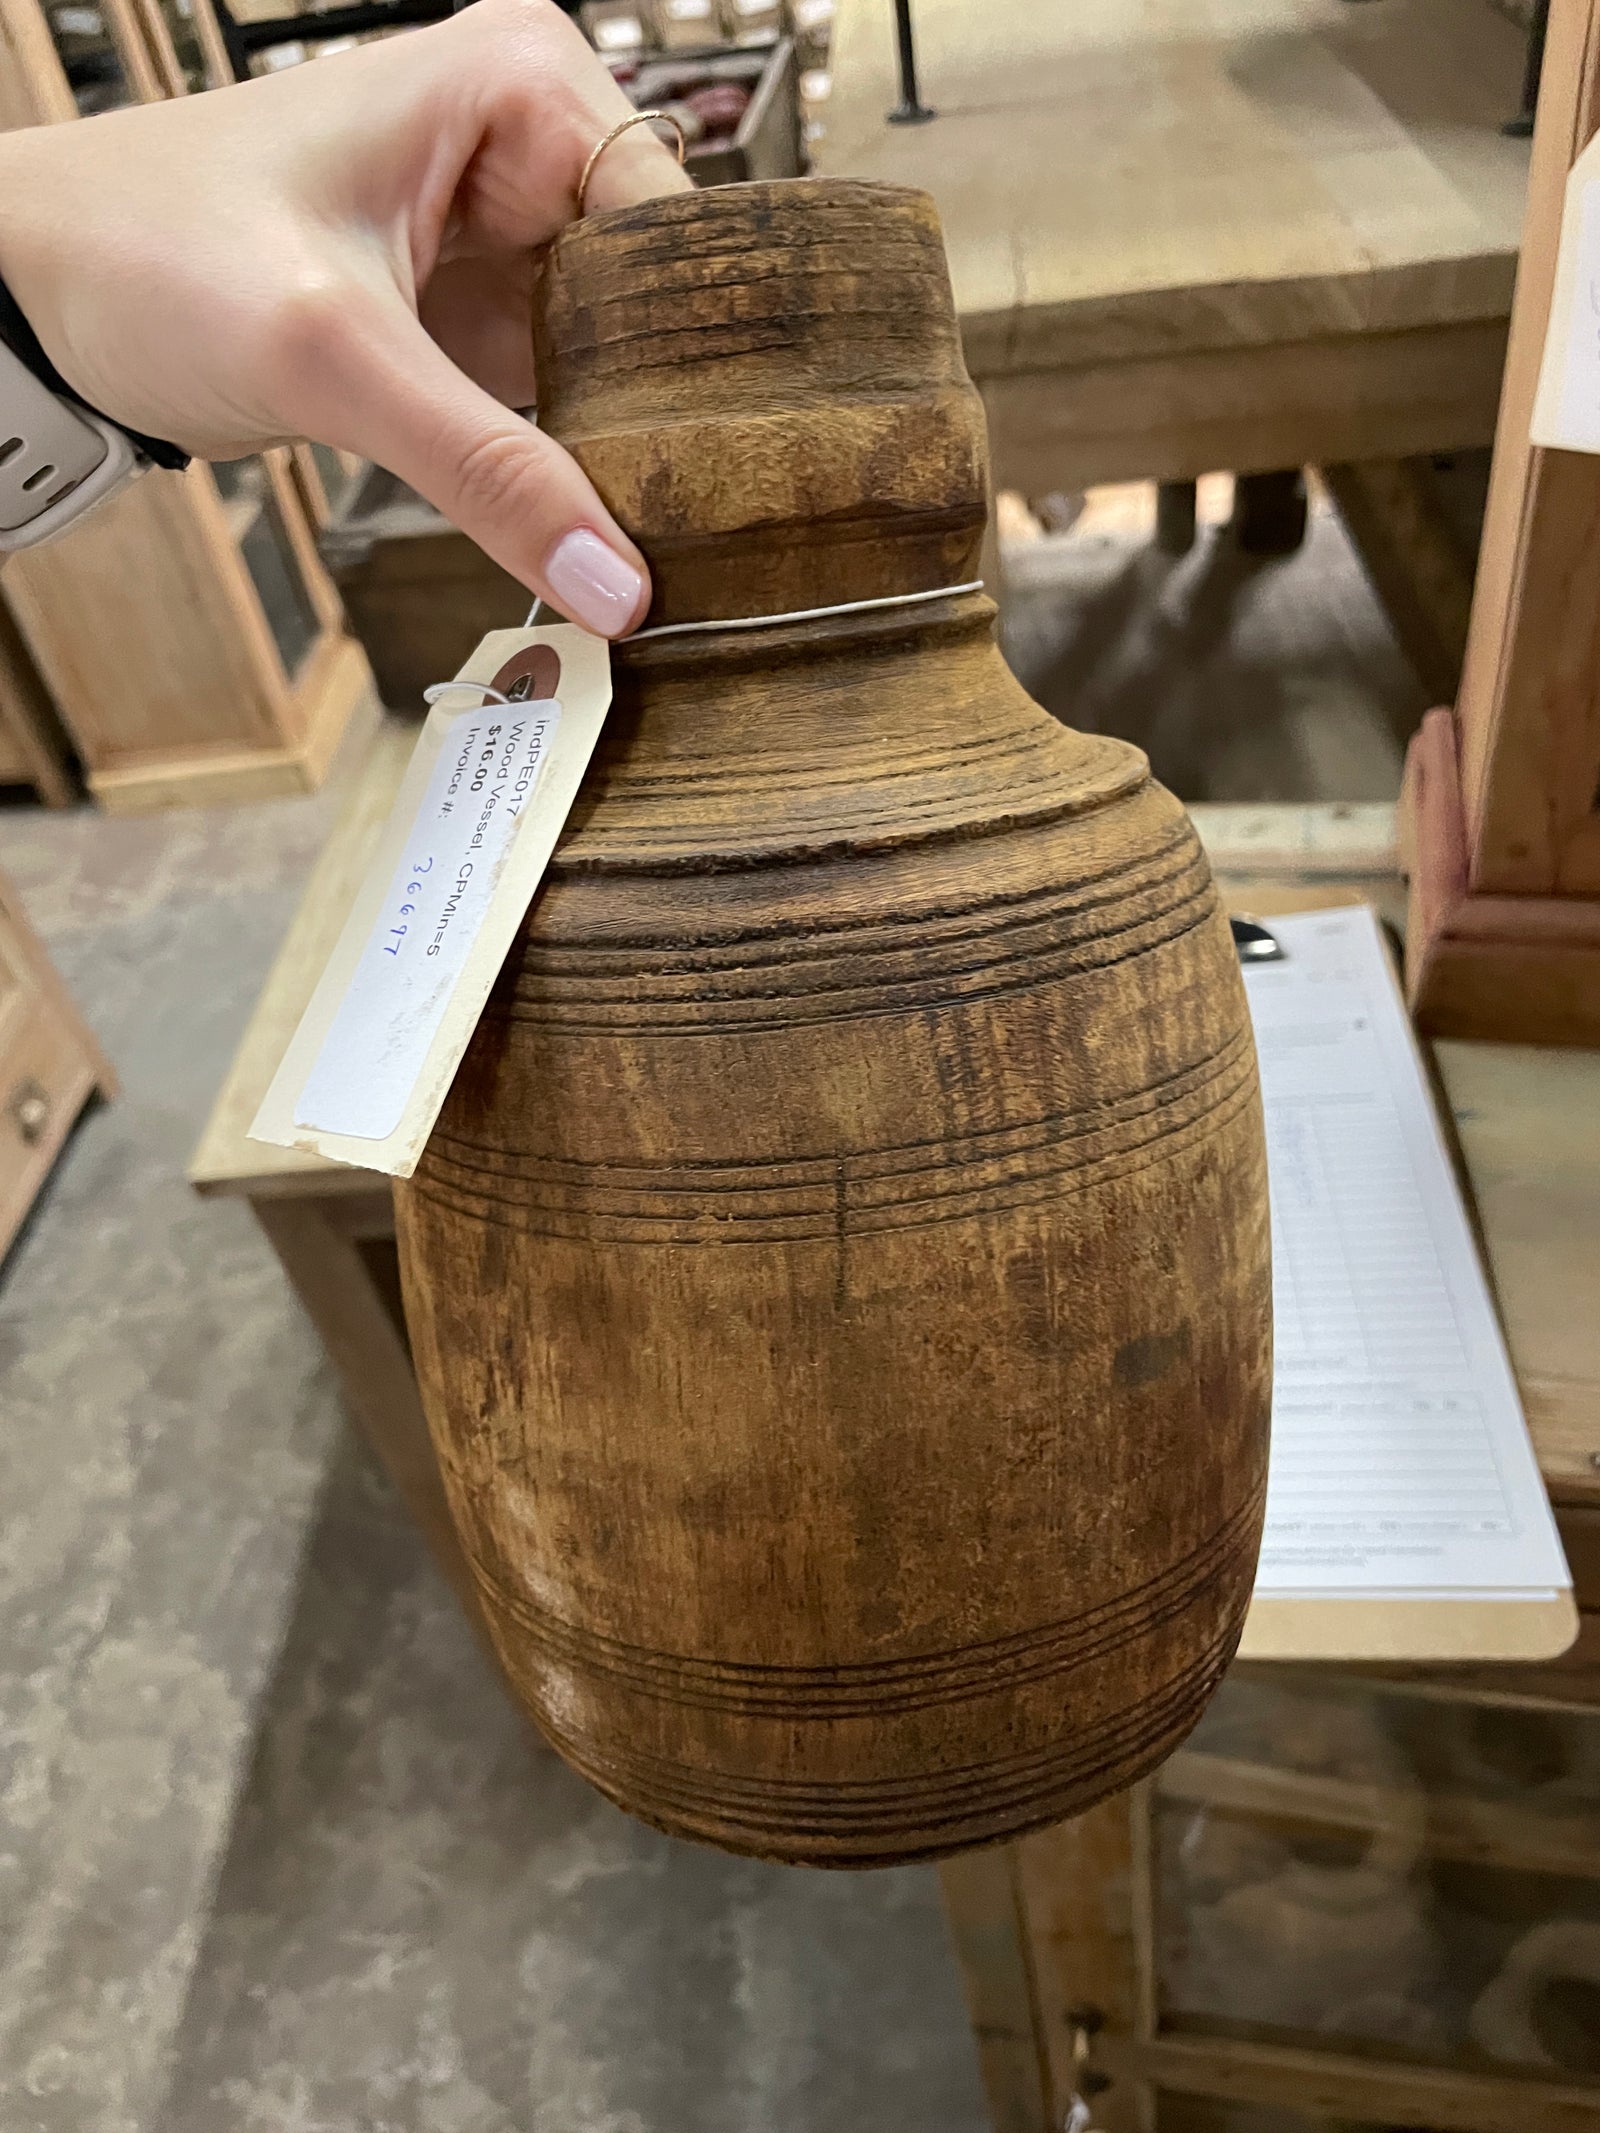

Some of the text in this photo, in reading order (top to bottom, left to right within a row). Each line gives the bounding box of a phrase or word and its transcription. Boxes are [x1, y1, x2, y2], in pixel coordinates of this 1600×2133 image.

[448, 728, 480, 794] Invoice
[470, 725, 502, 791] $16.00
[507, 720, 550, 816] indPE017
[427, 721, 526, 956] Wood Vessel, CPMin=5
[383, 857, 433, 956] 36697
